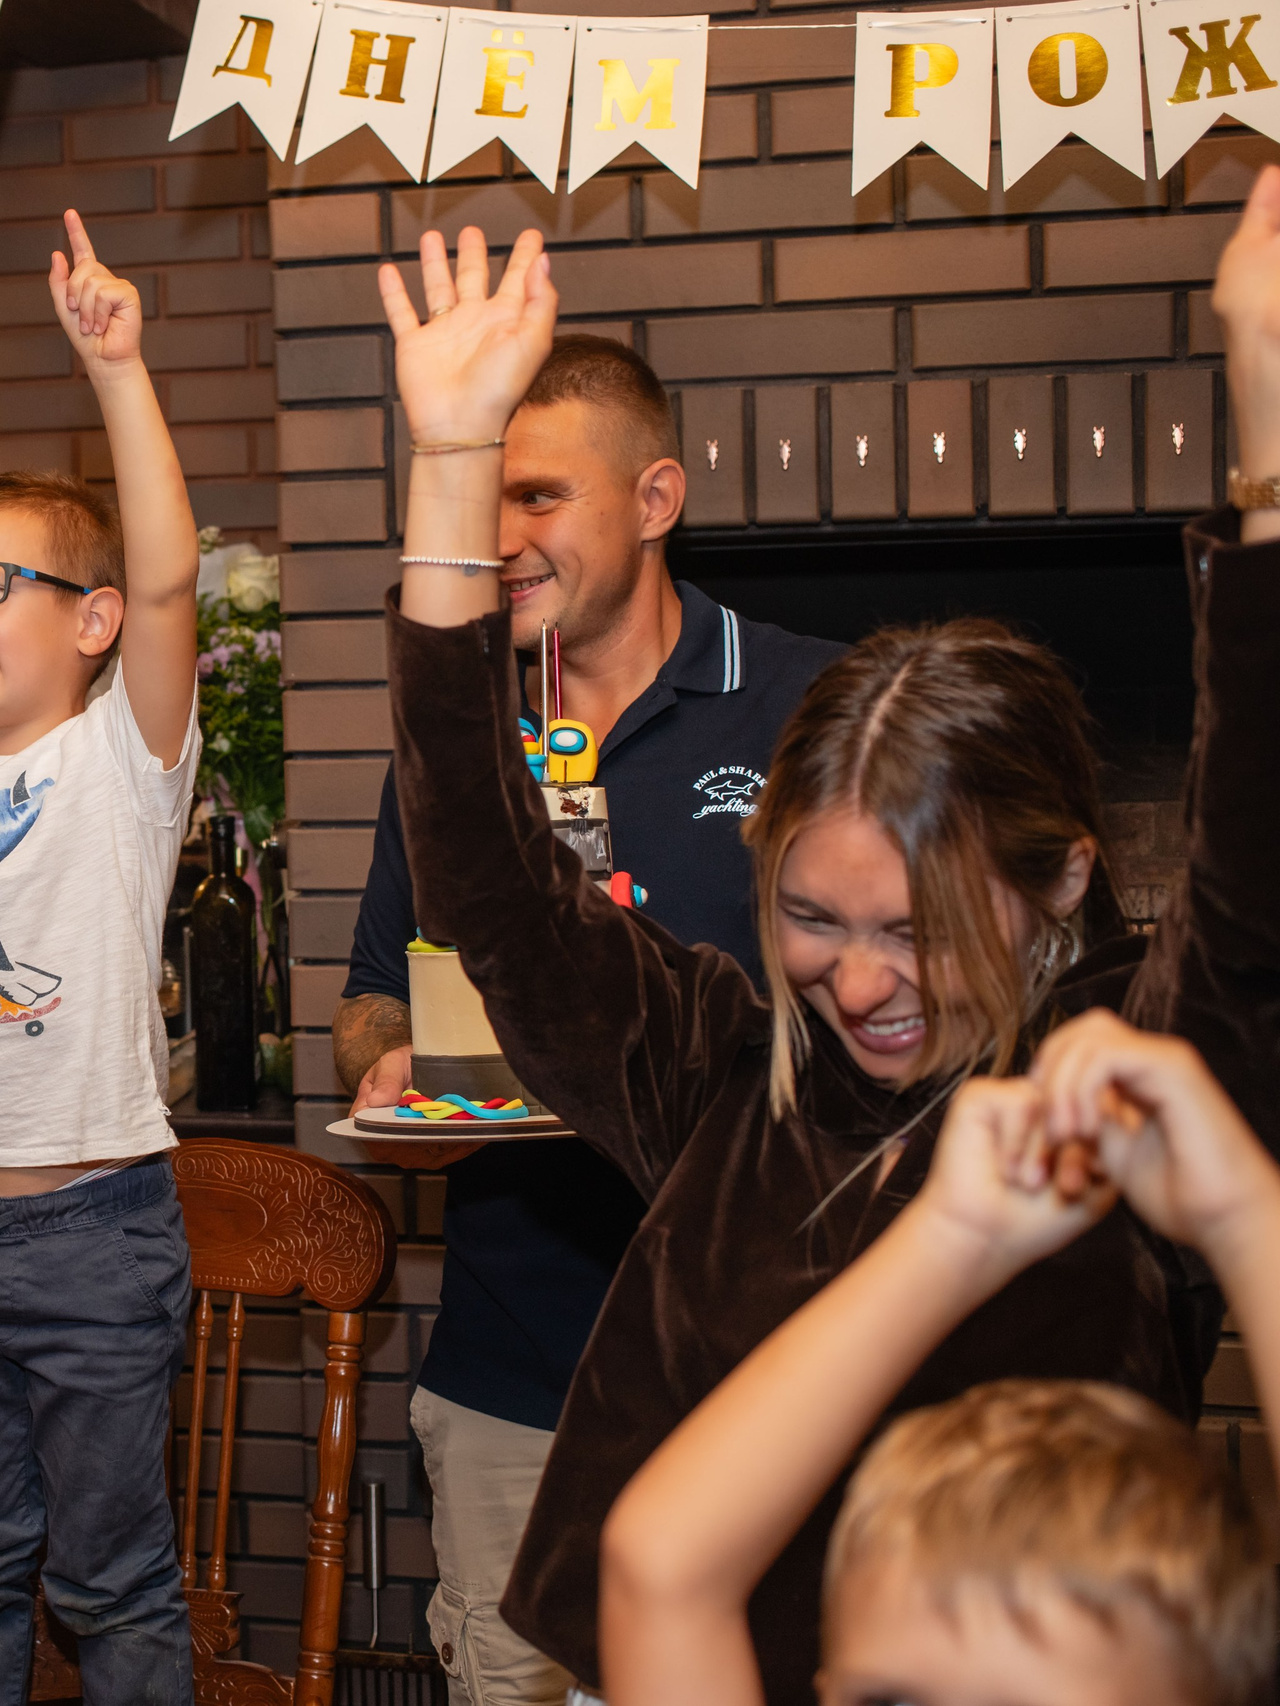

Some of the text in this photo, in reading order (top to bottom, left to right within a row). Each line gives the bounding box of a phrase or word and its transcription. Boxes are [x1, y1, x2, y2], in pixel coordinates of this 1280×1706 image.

[212, 14, 1278, 131] ДНЁМ РОЖ
[692, 765, 768, 791] PAUL & SHARK
[692, 797, 758, 819] yachting
